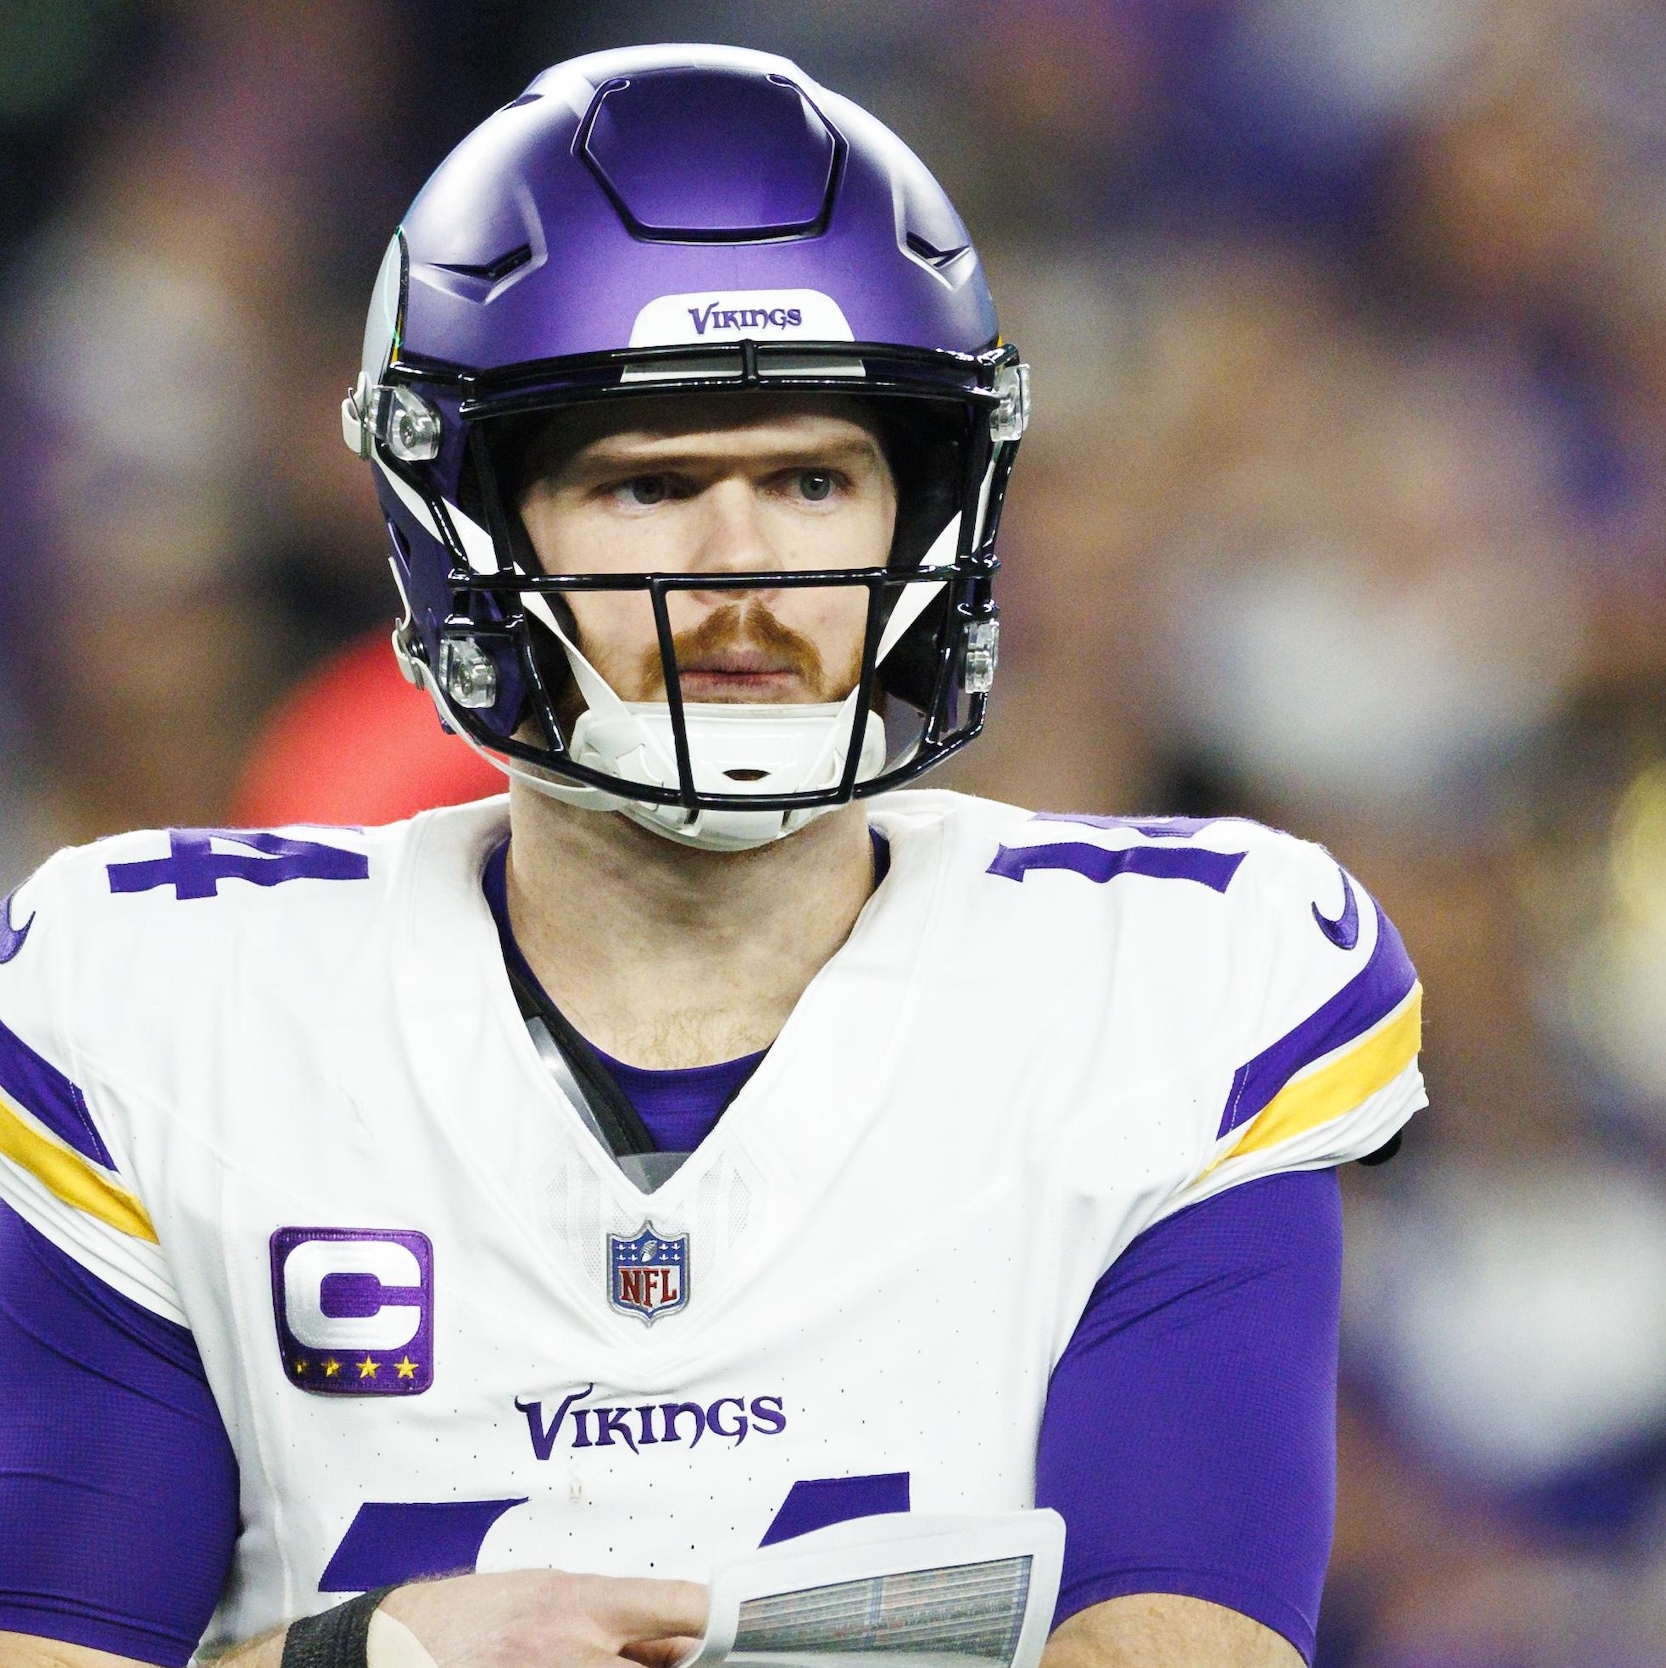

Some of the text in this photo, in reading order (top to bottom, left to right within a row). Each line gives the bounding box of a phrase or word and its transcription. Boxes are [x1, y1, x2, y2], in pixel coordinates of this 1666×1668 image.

[688, 301, 802, 335] VIKINGS
[283, 1240, 422, 1351] C
[620, 1267, 677, 1308] NFL
[514, 1382, 787, 1461] VIKINGS
